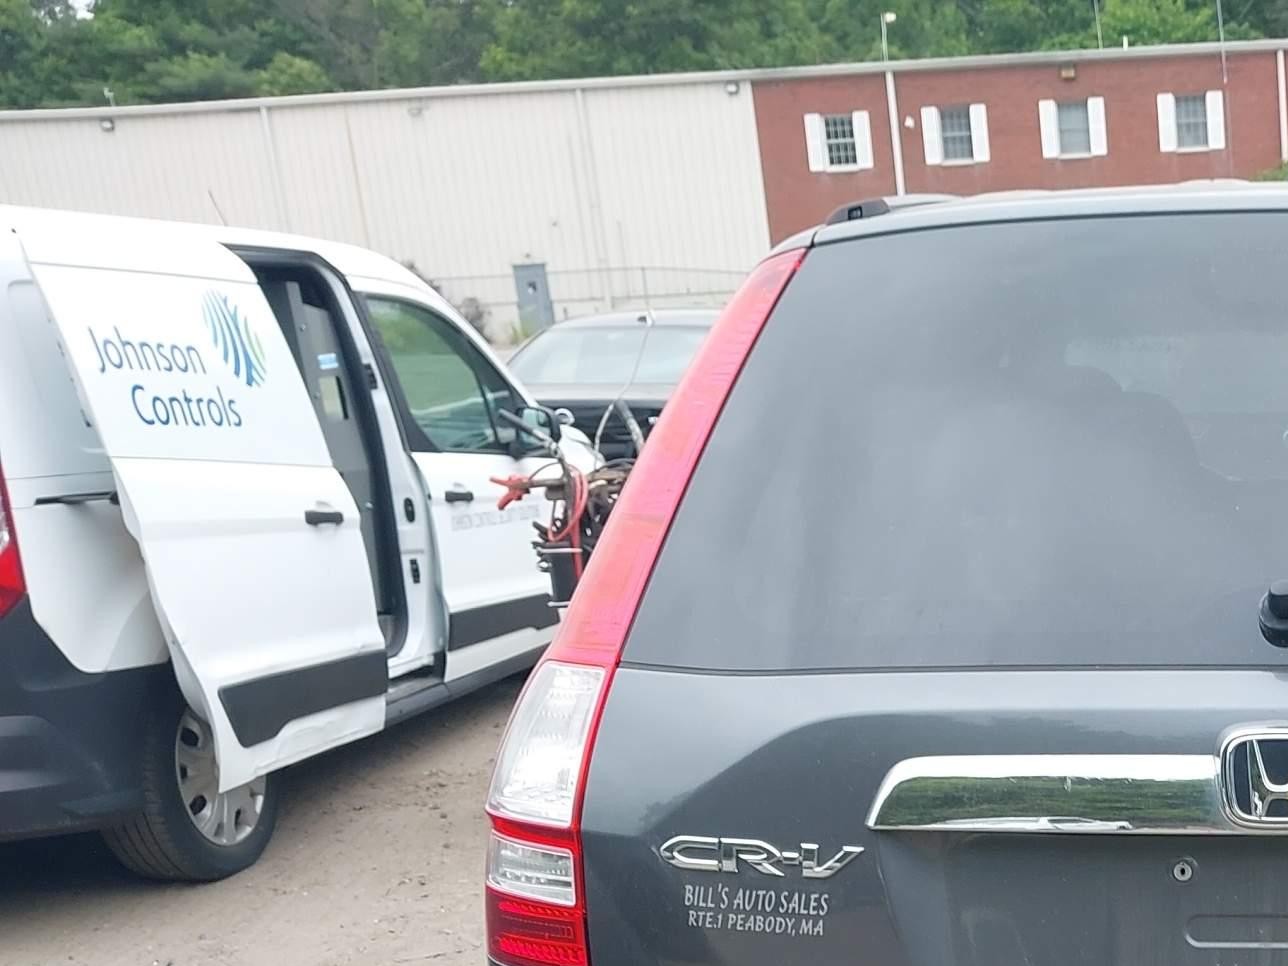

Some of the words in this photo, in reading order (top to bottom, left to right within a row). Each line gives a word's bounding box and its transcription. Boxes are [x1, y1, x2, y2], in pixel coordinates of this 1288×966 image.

[87, 325, 207, 374] Johnson
[131, 384, 242, 427] Controls
[660, 835, 865, 878] CR-V
[684, 883, 729, 910] BILL'S
[733, 888, 776, 913] AUTO
[779, 891, 830, 916] SALES
[688, 911, 723, 929] RTE.1
[727, 914, 796, 937] PEABODY,
[799, 918, 824, 936] MA
